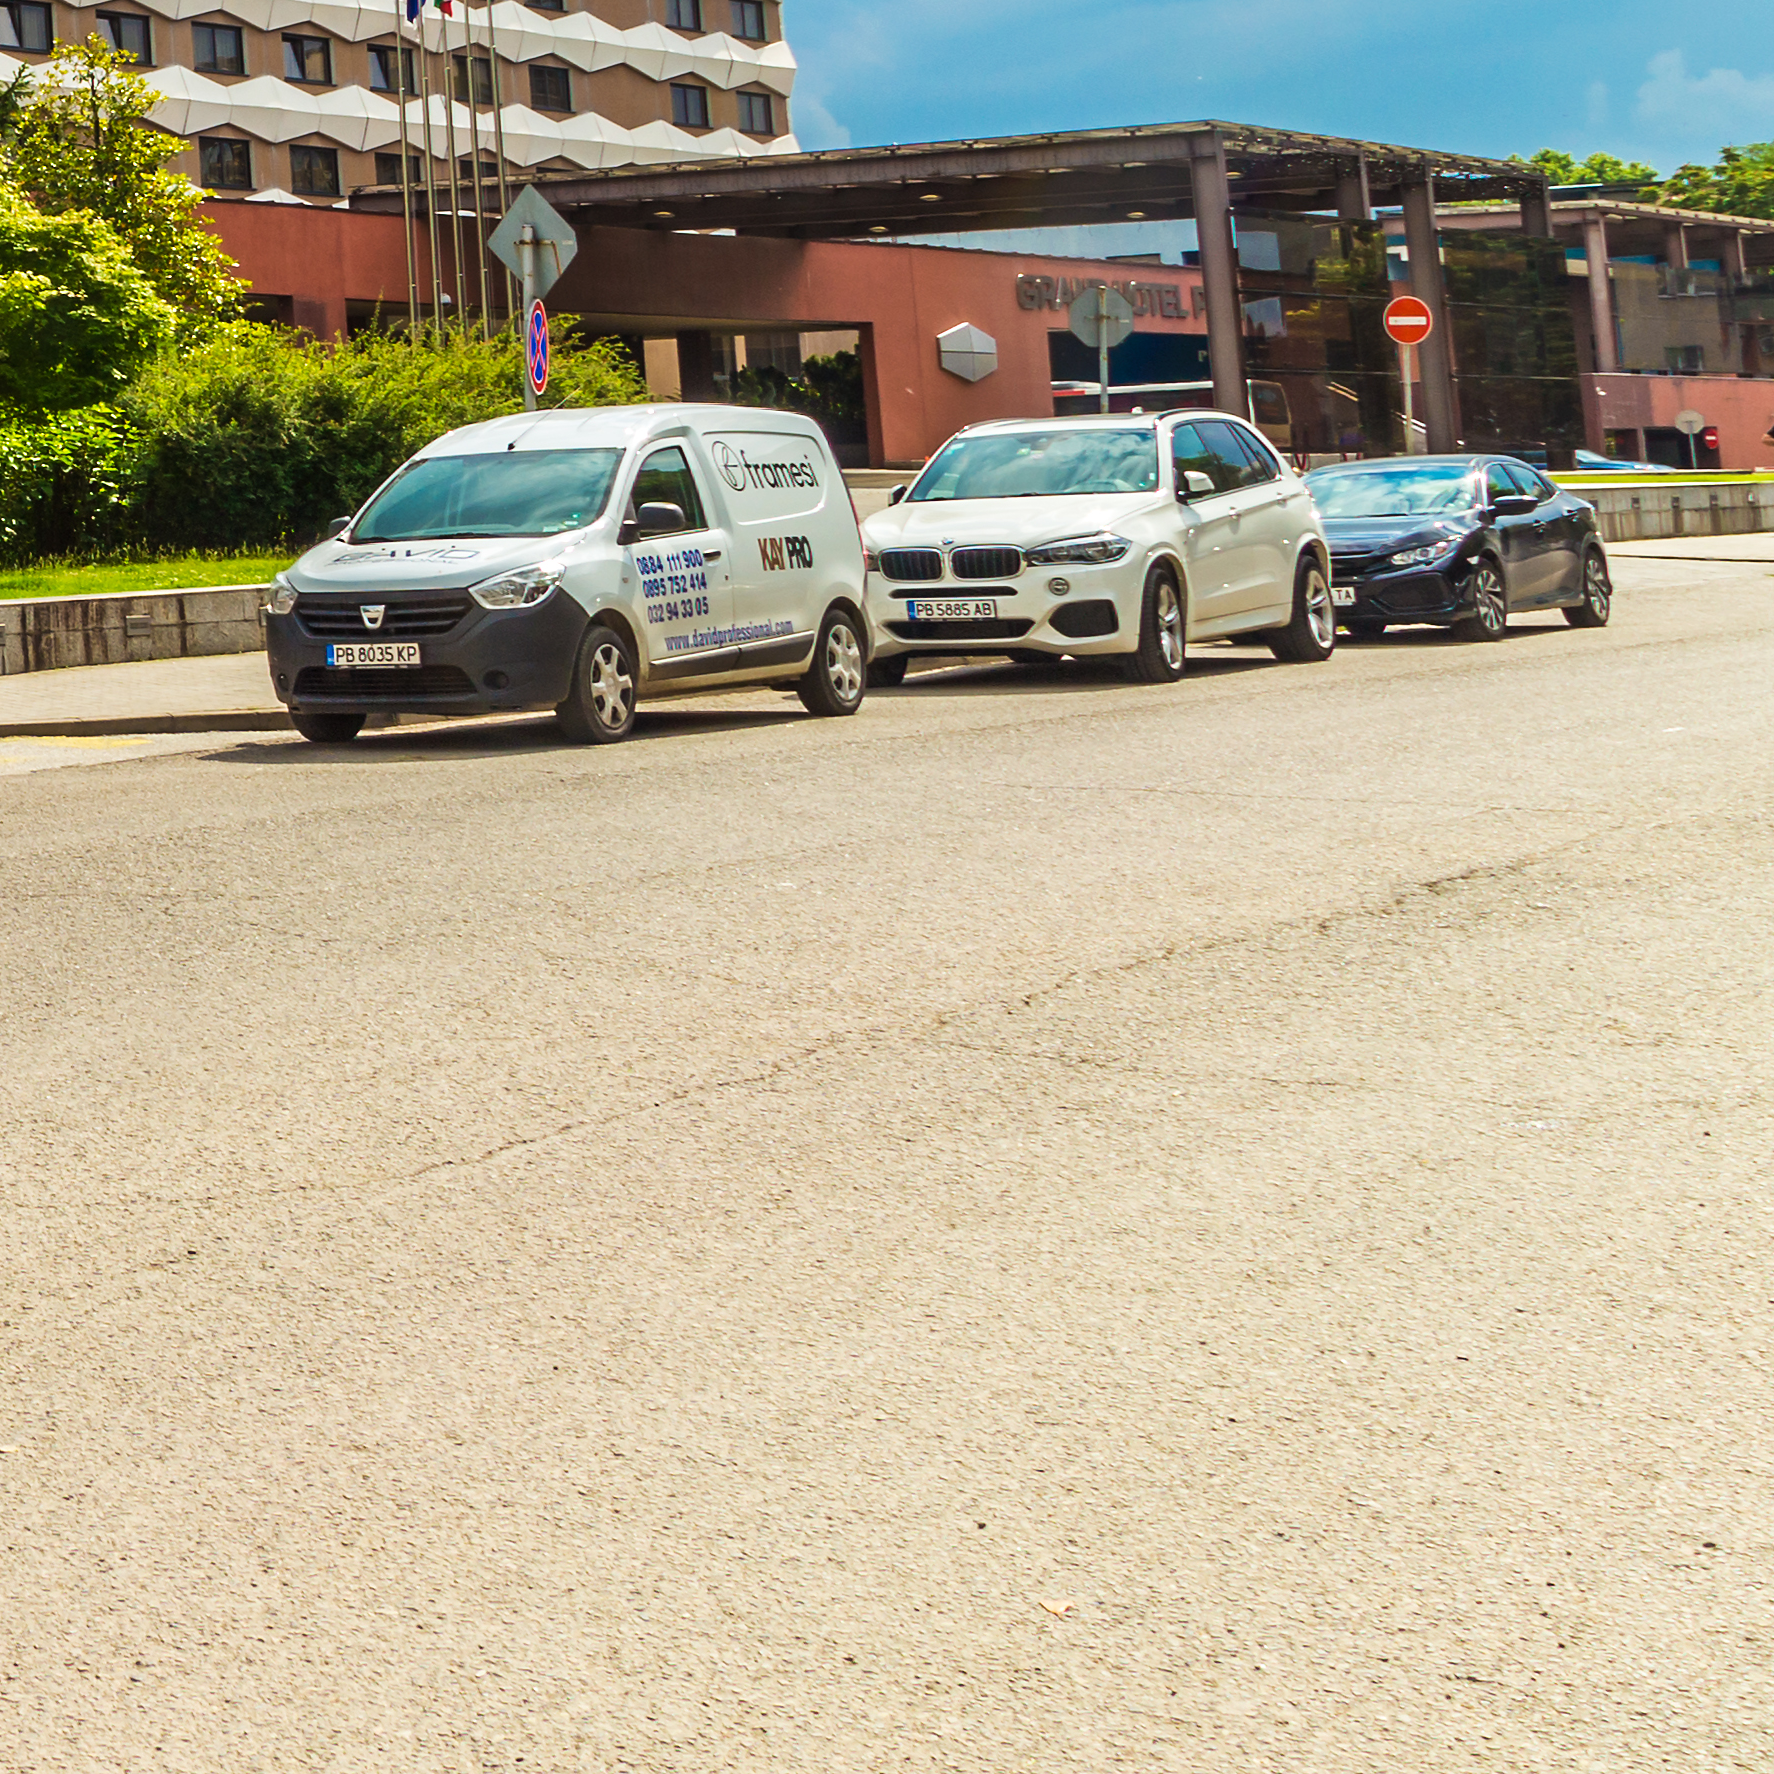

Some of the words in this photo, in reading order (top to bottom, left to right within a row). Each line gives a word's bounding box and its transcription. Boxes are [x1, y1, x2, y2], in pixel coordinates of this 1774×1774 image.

[1016, 273, 1107, 312] GRA
[740, 449, 819, 489] framesi
[667, 552, 683, 572] 111
[682, 548, 703, 568] 900
[757, 537, 785, 571] KAY
[784, 535, 814, 569] PRO
[667, 574, 688, 594] 752
[690, 572, 708, 591] 414
[1334, 589, 1353, 600] TA
[647, 603, 665, 624] 032
[666, 601, 679, 621] 94
[681, 598, 694, 618] 33
[695, 596, 709, 616] 05
[915, 603, 934, 616] PB
[936, 603, 971, 616] 5885
[974, 602, 992, 616] AB
[335, 647, 355, 663] PB
[358, 646, 394, 662] 8035
[397, 646, 417, 662] KP
